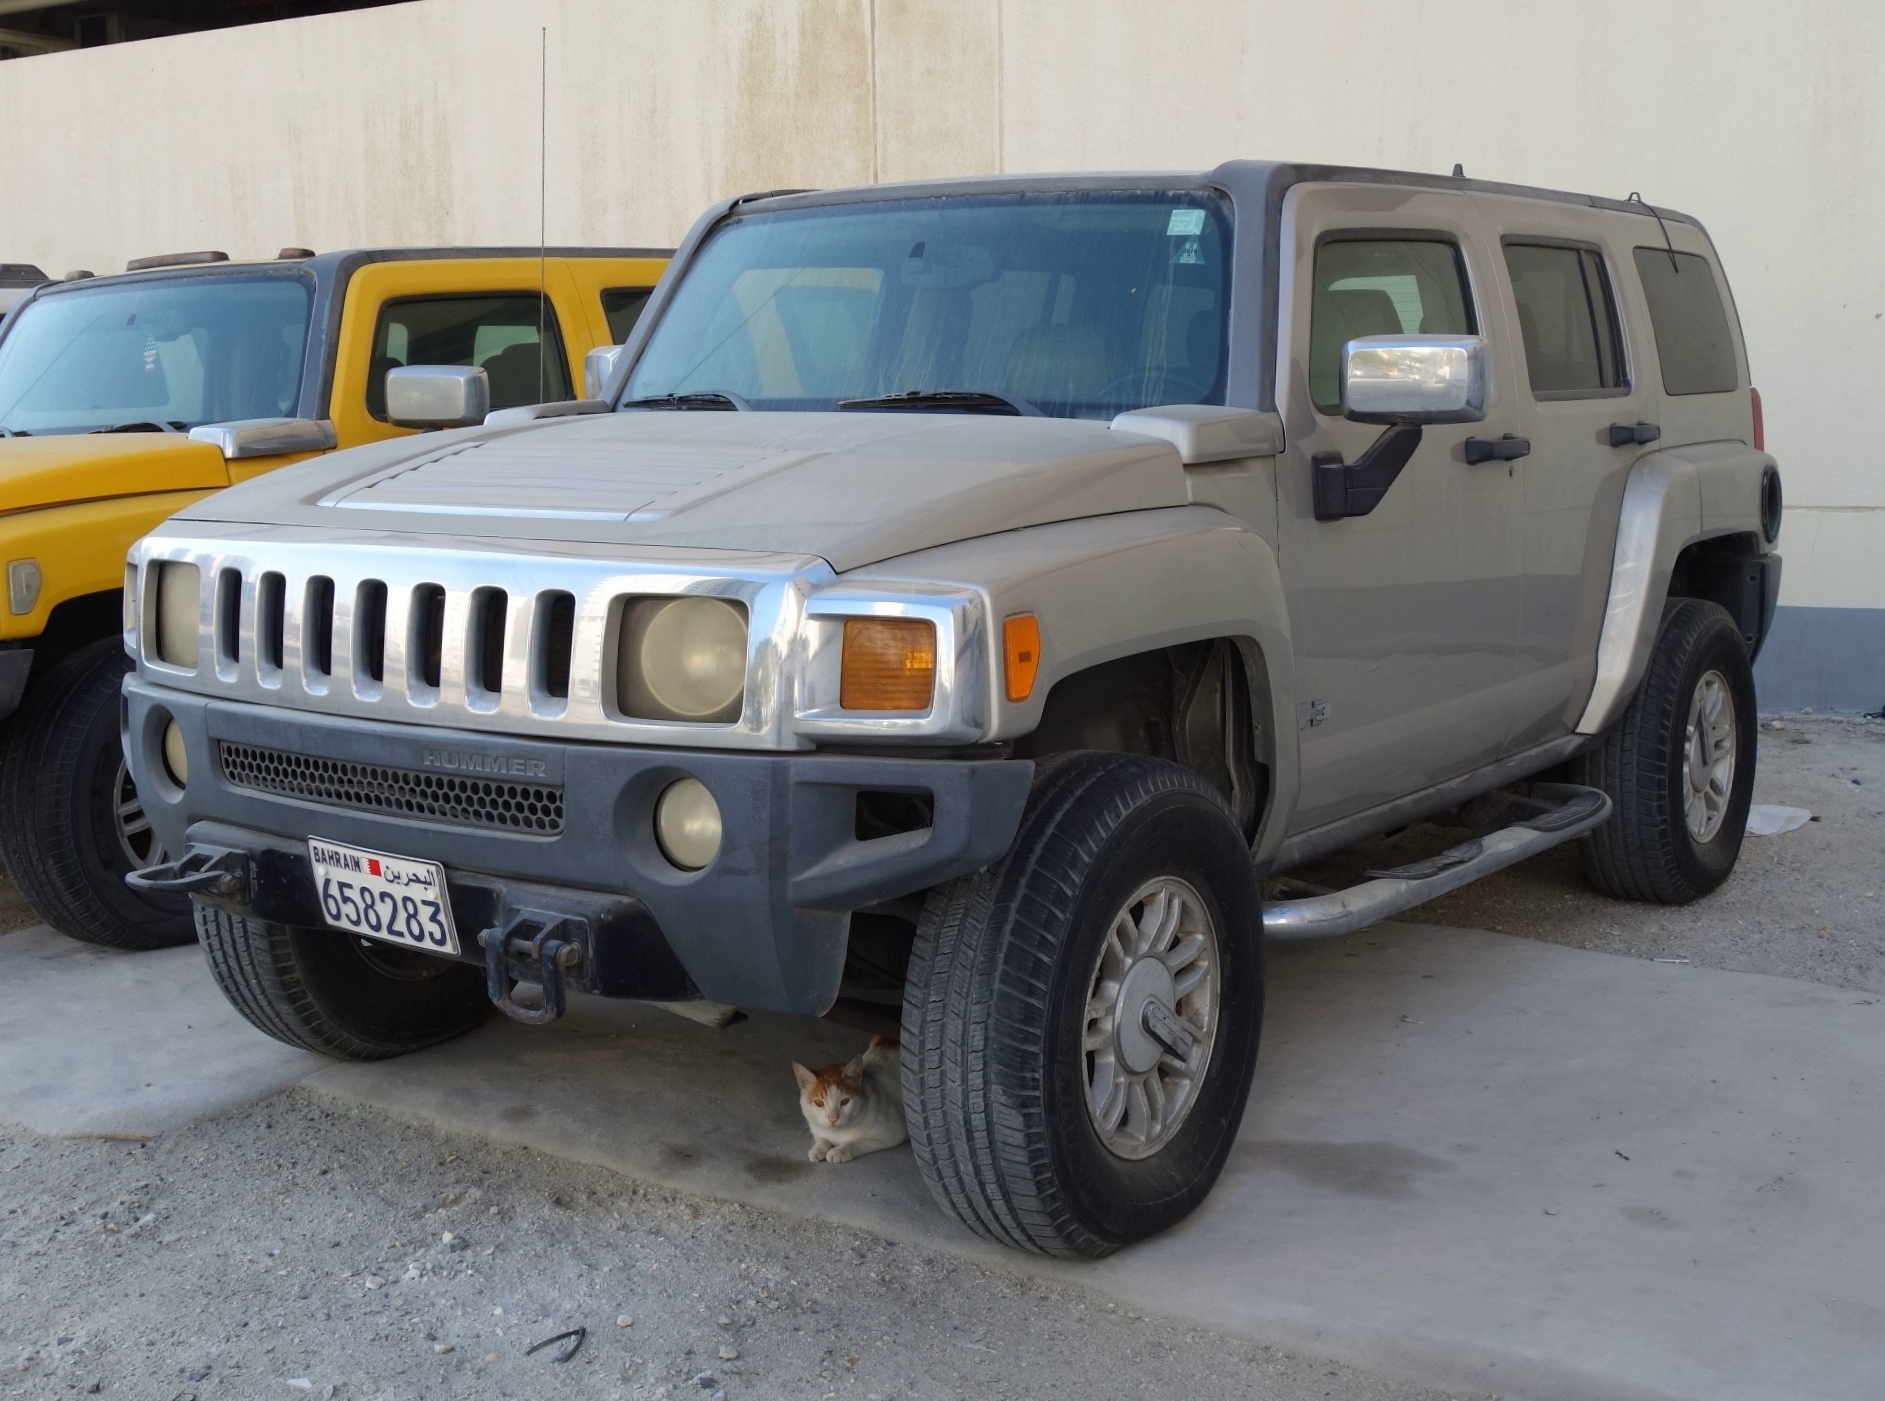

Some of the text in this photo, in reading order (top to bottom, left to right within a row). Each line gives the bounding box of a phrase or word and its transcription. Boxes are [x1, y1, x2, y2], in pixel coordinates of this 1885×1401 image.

[423, 750, 547, 778] HUMMER
[313, 845, 362, 873] BAHRAIN
[384, 865, 437, 891] البحرين
[322, 878, 447, 947] 658283
